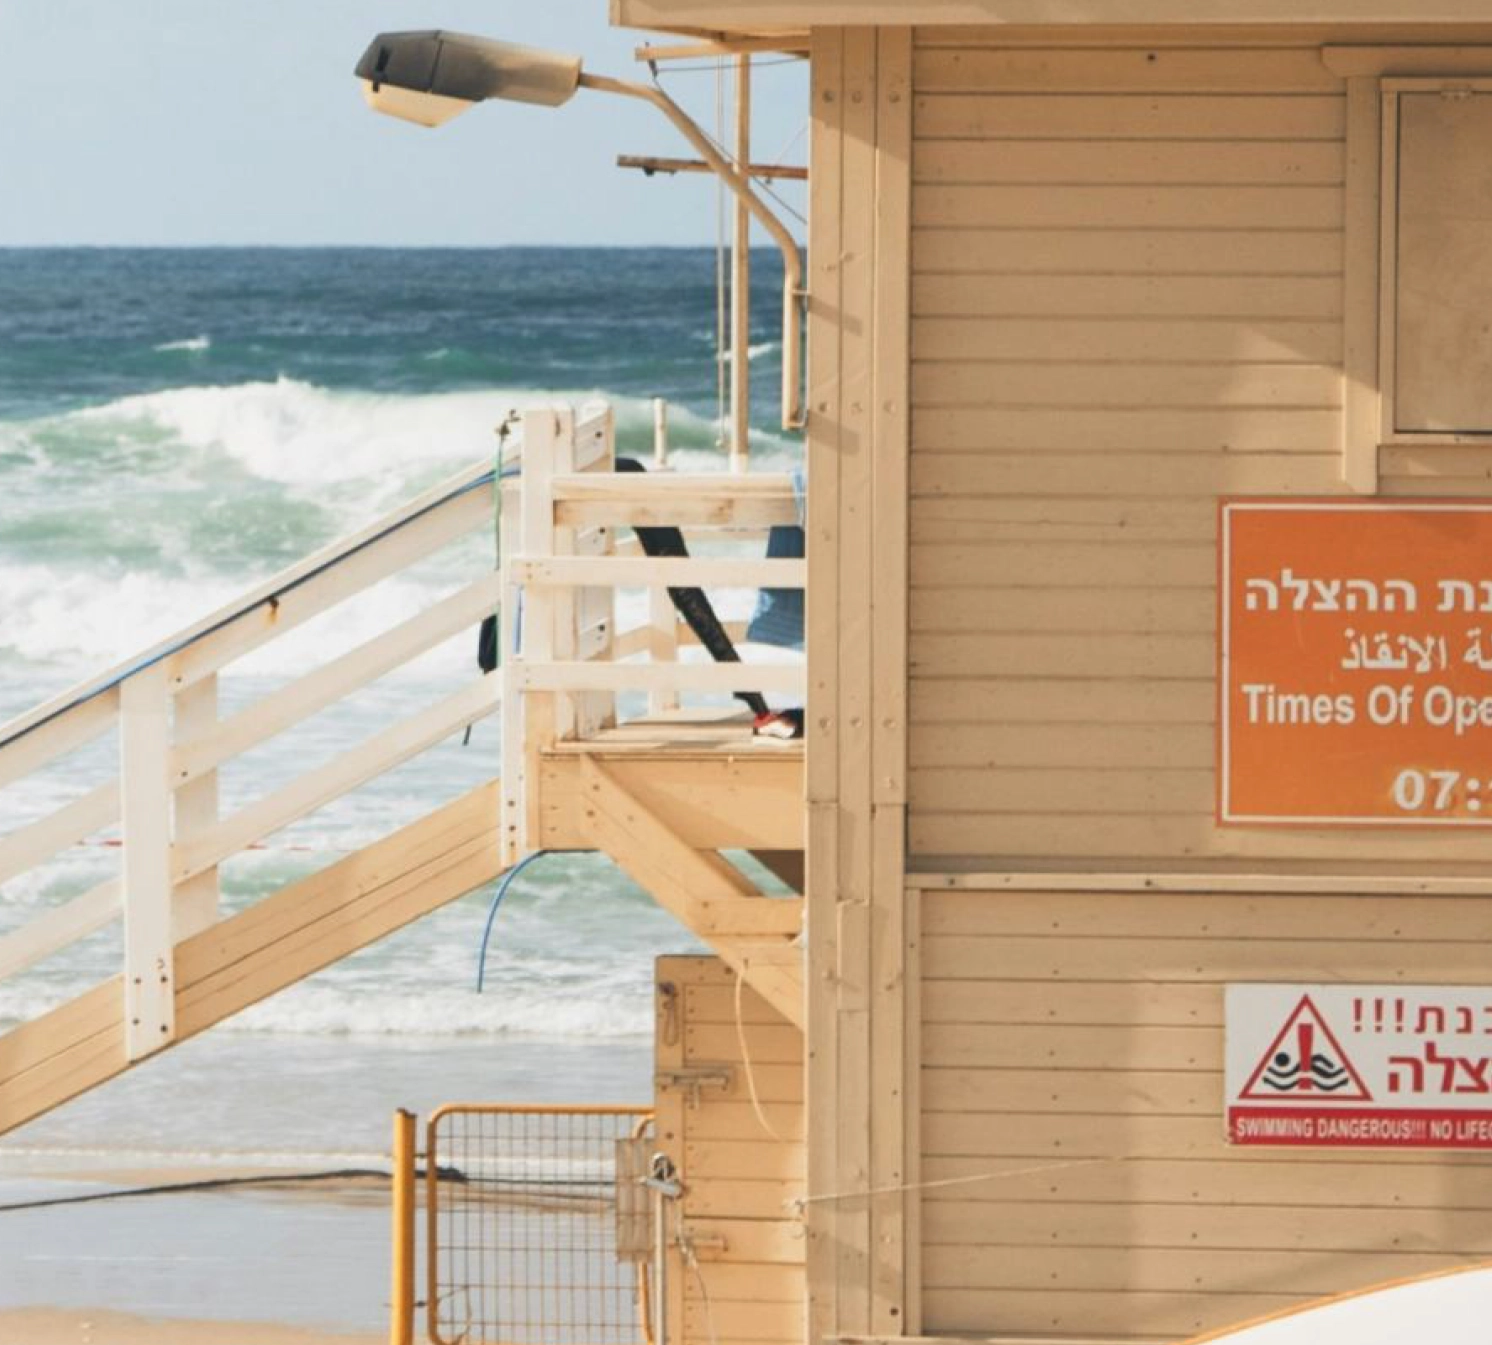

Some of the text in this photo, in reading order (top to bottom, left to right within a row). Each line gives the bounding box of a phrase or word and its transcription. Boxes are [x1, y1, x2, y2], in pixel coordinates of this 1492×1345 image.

[1246, 568, 1417, 611] ההצלה
[1241, 683, 1355, 724] Times
[1368, 685, 1414, 724] Of
[1237, 1116, 1313, 1137] SWIMMING
[1318, 1118, 1426, 1139] DANGEROUS!!!
[1430, 1120, 1453, 1140] NO
